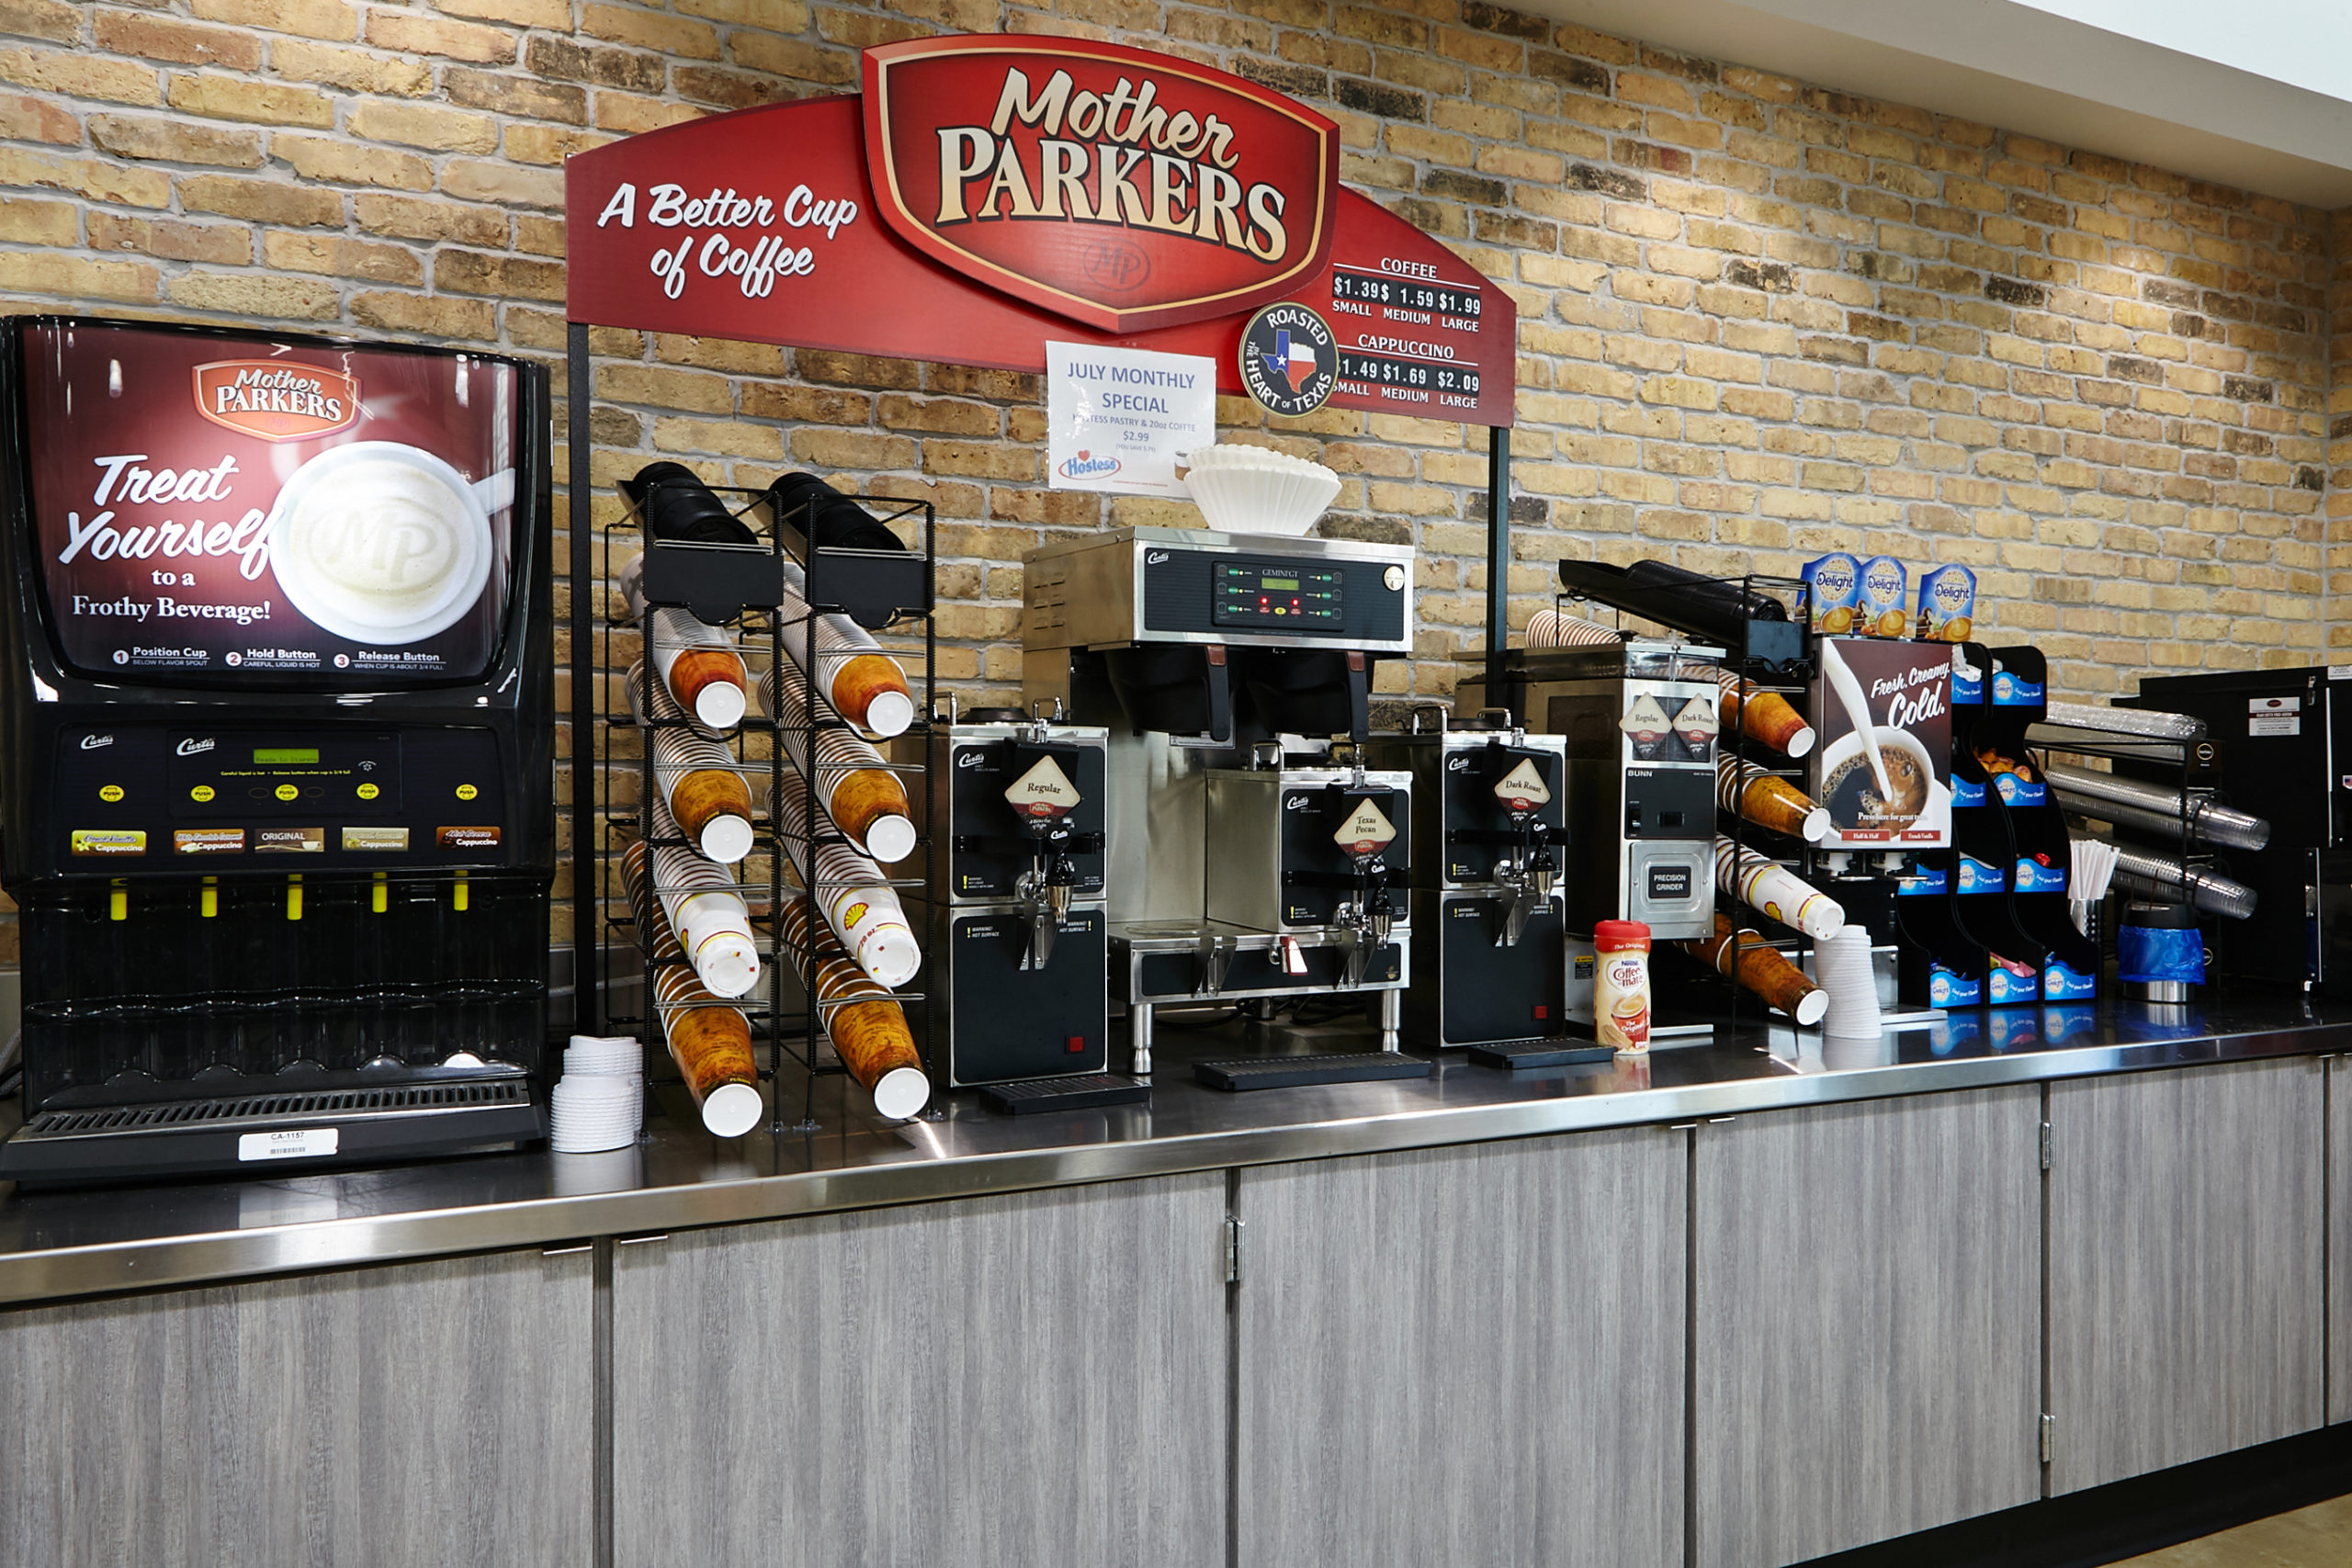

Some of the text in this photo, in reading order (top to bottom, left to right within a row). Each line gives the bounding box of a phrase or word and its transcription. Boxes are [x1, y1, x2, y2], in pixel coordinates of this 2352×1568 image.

[990, 66, 1239, 169] Mother
[934, 126, 1288, 264] PARKERS
[597, 183, 858, 240] A Better Cup
[650, 232, 815, 299] of Coffee
[1380, 257, 1438, 279] COFFEE
[1439, 292, 1481, 315] $1.99
[1332, 300, 1479, 333] SMALL MEDIUM LARGE
[1266, 309, 1329, 346] ROASTED
[1246, 341, 1257, 357] THE
[1358, 333, 1454, 359] CAPPUCCINO
[234, 368, 322, 395] Mother
[1068, 362, 1196, 389] JULY MONTHLY
[1383, 363, 1427, 385] $1.69
[1438, 370, 1480, 392] $2.09
[1246, 359, 1282, 409] HEART
[1293, 372, 1332, 412] TEXAS
[216, 386, 342, 422] PARKERS
[1102, 392, 1170, 413] SPECIAL
[1381, 387, 1429, 403] MEDIUM
[1440, 394, 1478, 409] LARGE
[1110, 416, 1139, 427] PASTRY
[1140, 419, 1148, 428] &
[1169, 423, 1196, 433] COFFEE
[1123, 430, 1149, 442] $2.99
[1067, 457, 1116, 477] Hostess
[94, 454, 240, 506] Treat
[59, 508, 285, 581] Yourself
[1147, 551, 1170, 565] Curtis
[151, 570, 196, 586] to a
[1815, 571, 1854, 592] Delight
[1868, 575, 1902, 594] Delight
[1934, 583, 1970, 603] Delight
[72, 595, 271, 626] Frothy Beverage!
[132, 646, 180, 657] Position
[184, 647, 208, 659] Cup
[246, 649, 275, 659] Hold
[277, 649, 317, 660] Button
[358, 650, 400, 661] Release
[403, 652, 440, 661] Button
[1871, 661, 1951, 699] Fresh. Creamy.
[1887, 680, 1945, 730] Cold.
[1635, 714, 1658, 724] Regular
[1698, 715, 1713, 725] Roast
[81, 734, 115, 750] Curtis
[175, 738, 216, 756] Curtis
[958, 752, 985, 768] Curtis
[1448, 757, 1470, 771] Curtis
[1026, 782, 1062, 795] Regular
[1505, 780, 1543, 794] Dark Roast
[1287, 795, 1309, 809] Curtis
[1356, 816, 1376, 825] Texas
[261, 832, 306, 840] ORIGINAL
[1355, 825, 1376, 834] Pecan
[95, 843, 144, 852] Cappuccino
[197, 841, 243, 851] Cappuccino
[360, 840, 404, 849] Cappuccino
[456, 838, 498, 847] Cappuccino
[1654, 874, 1687, 882] PRECISION
[1656, 883, 1684, 891] GRINDER
[1613, 966, 1641, 981] Coffee
[270, 1132, 305, 1140] CA-1157
